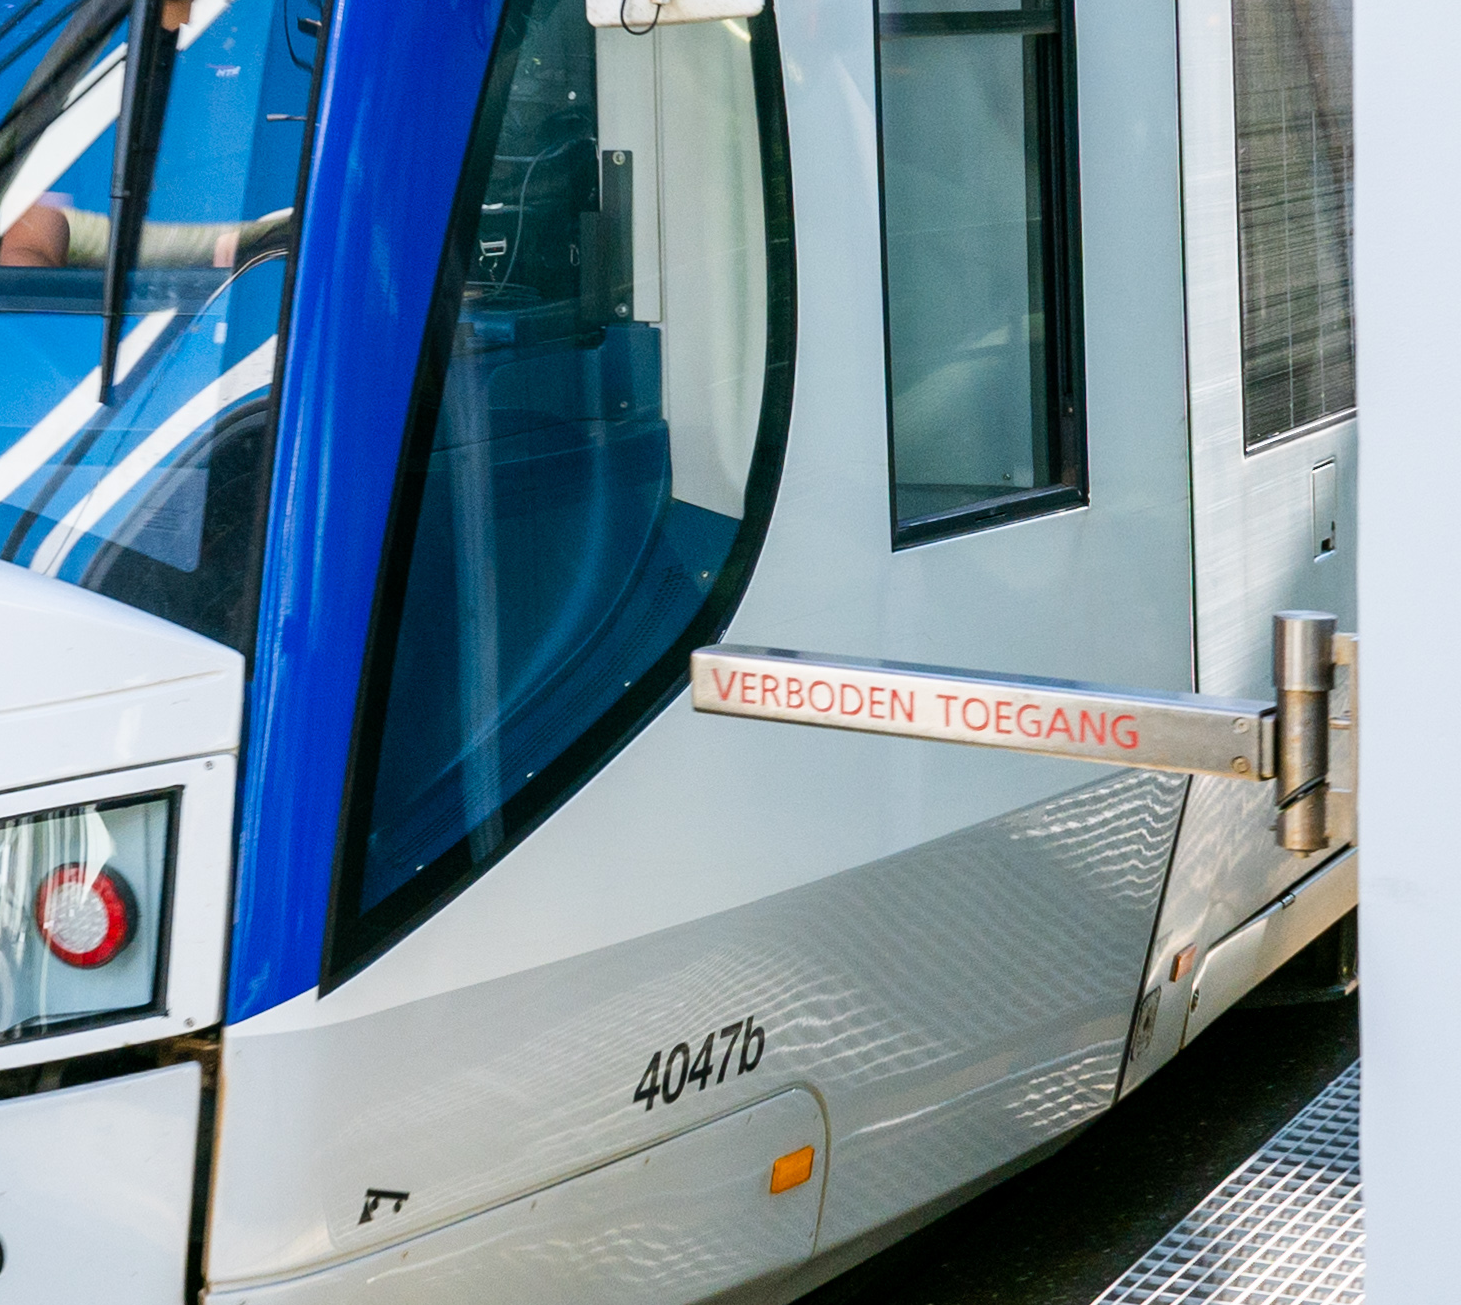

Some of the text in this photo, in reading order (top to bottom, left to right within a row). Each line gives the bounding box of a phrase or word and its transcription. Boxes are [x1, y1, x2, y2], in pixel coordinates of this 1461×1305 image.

[711, 667, 1141, 750] VERBODEN TOEGANG
[632, 1015, 766, 1112] 4047b
